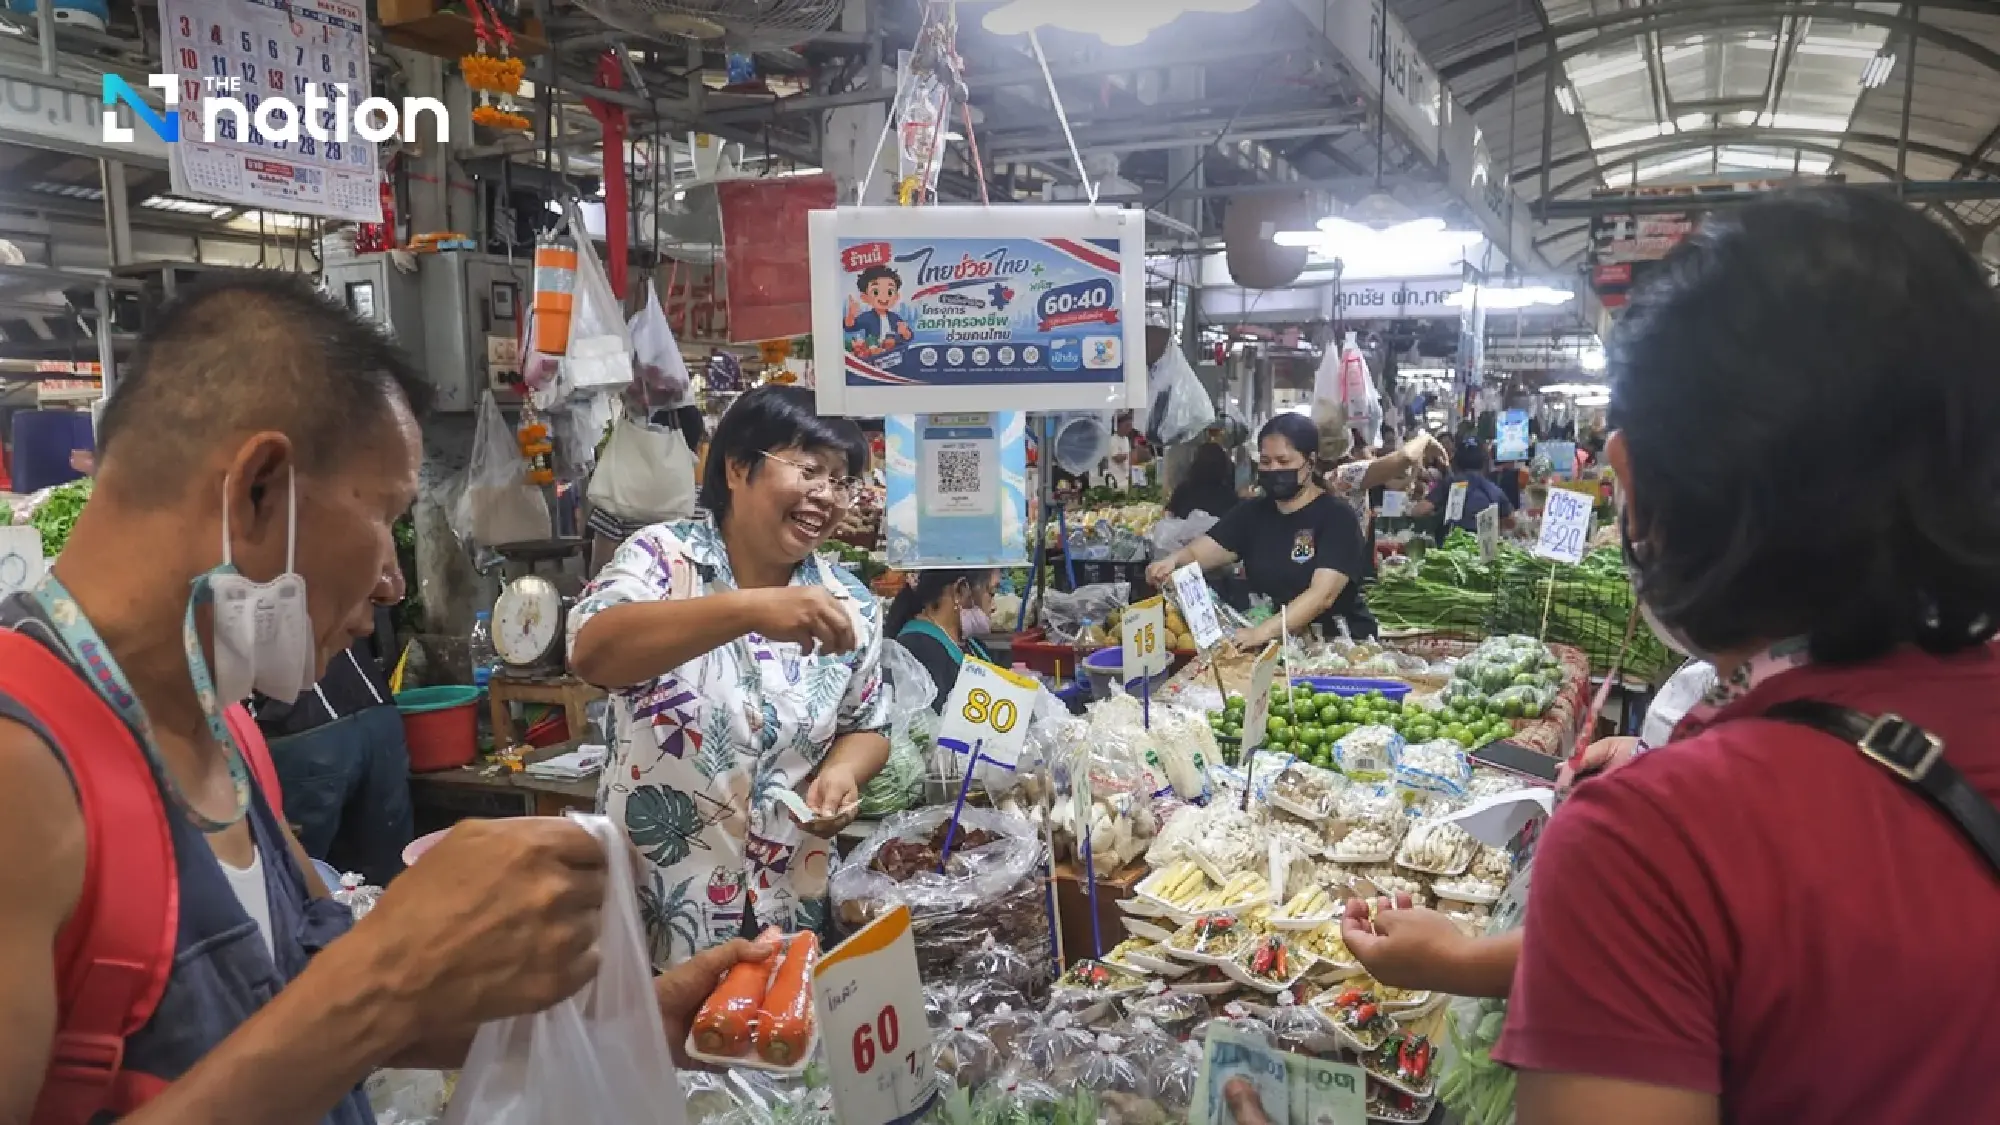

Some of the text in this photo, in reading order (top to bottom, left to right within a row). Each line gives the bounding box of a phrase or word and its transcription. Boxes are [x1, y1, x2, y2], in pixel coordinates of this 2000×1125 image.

[180, 16, 190, 37] 3
[241, 31, 251, 52] 5
[268, 39, 278, 59] 6
[297, 46, 304, 66] 7
[322, 54, 331, 72] 8
[180, 48, 198, 70] 10
[212, 55, 227, 76] 11
[242, 62, 257, 85] 12
[268, 68, 284, 90] 13
[184, 80, 200, 101] 17
[850, 244, 883, 267] ร้านนี้
[1045, 288, 1107, 315] 60:40
[1134, 622, 1155, 658] 15
[963, 688, 1018, 733] 80
[853, 1004, 899, 1074] 60
